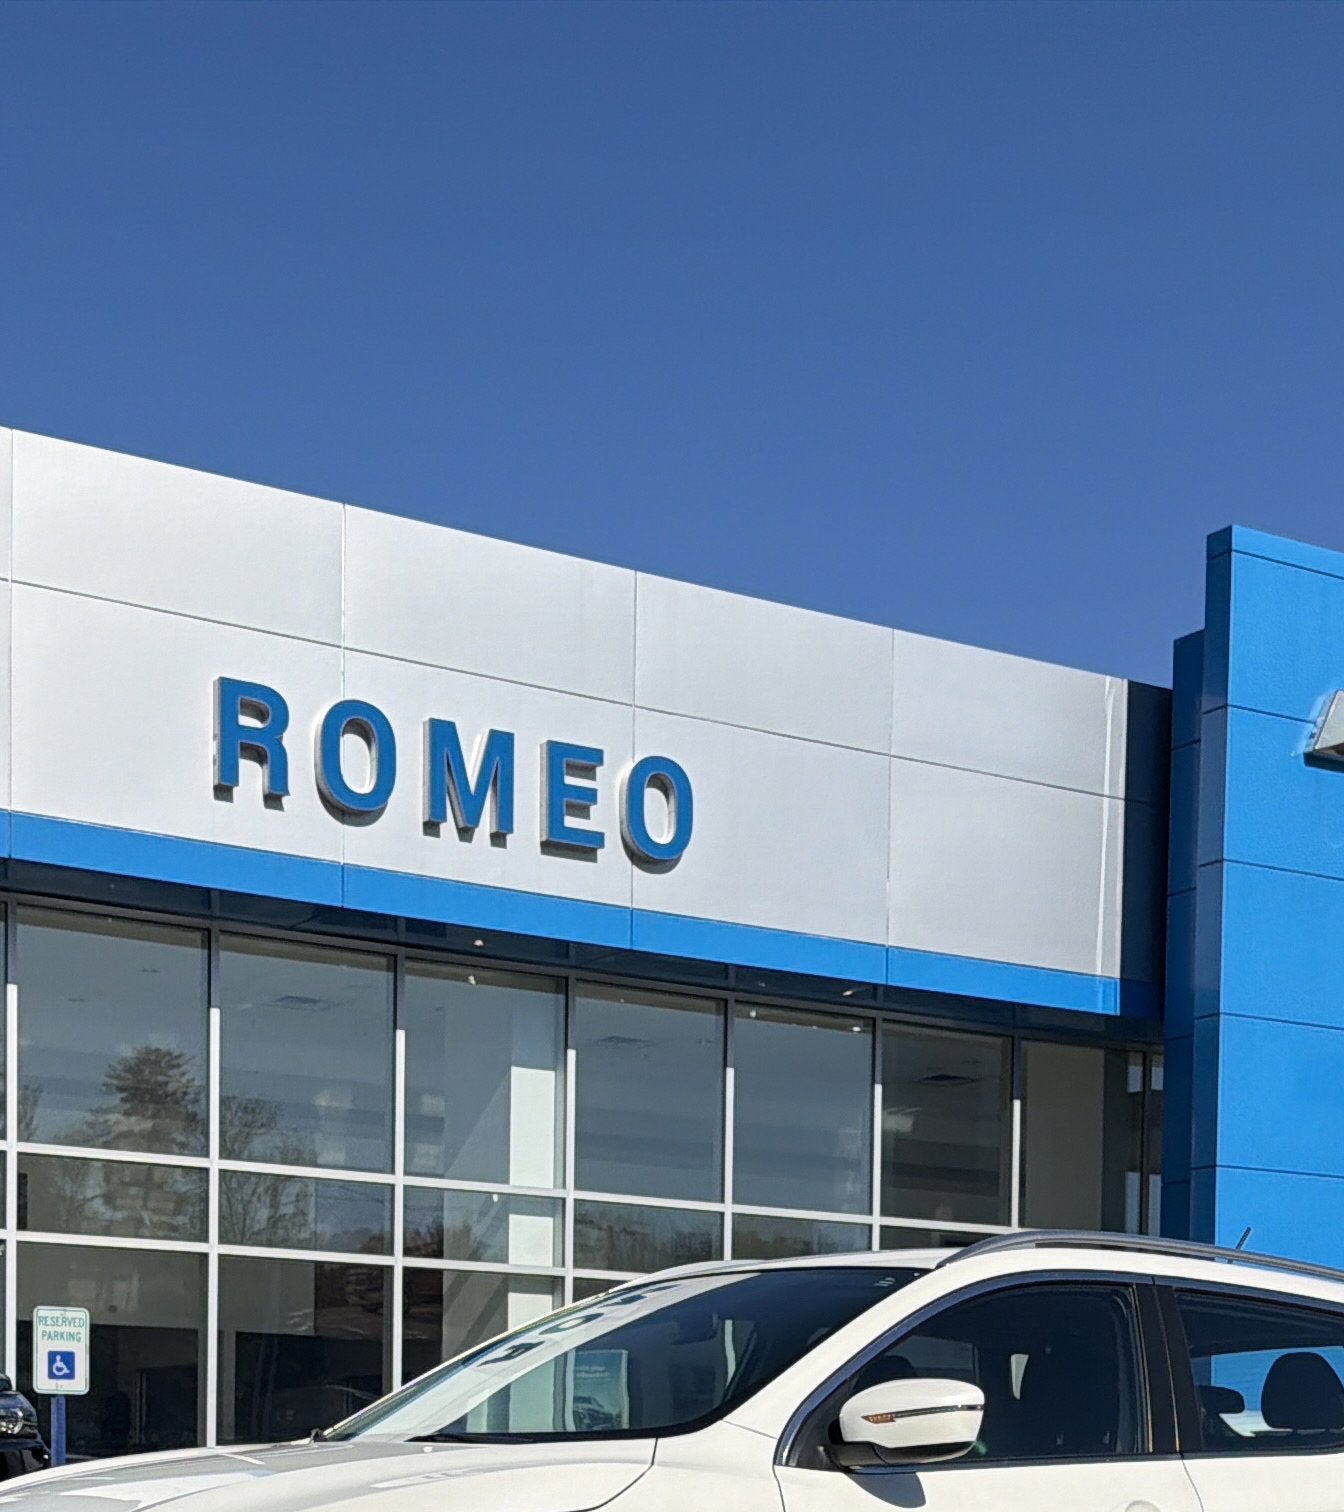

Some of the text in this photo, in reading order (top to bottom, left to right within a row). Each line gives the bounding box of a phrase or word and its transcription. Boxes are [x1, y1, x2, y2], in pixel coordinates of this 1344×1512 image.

[213, 676, 694, 864] ROMEO
[38, 1315, 85, 1329] RESERVED
[41, 1330, 82, 1343] PARKING
